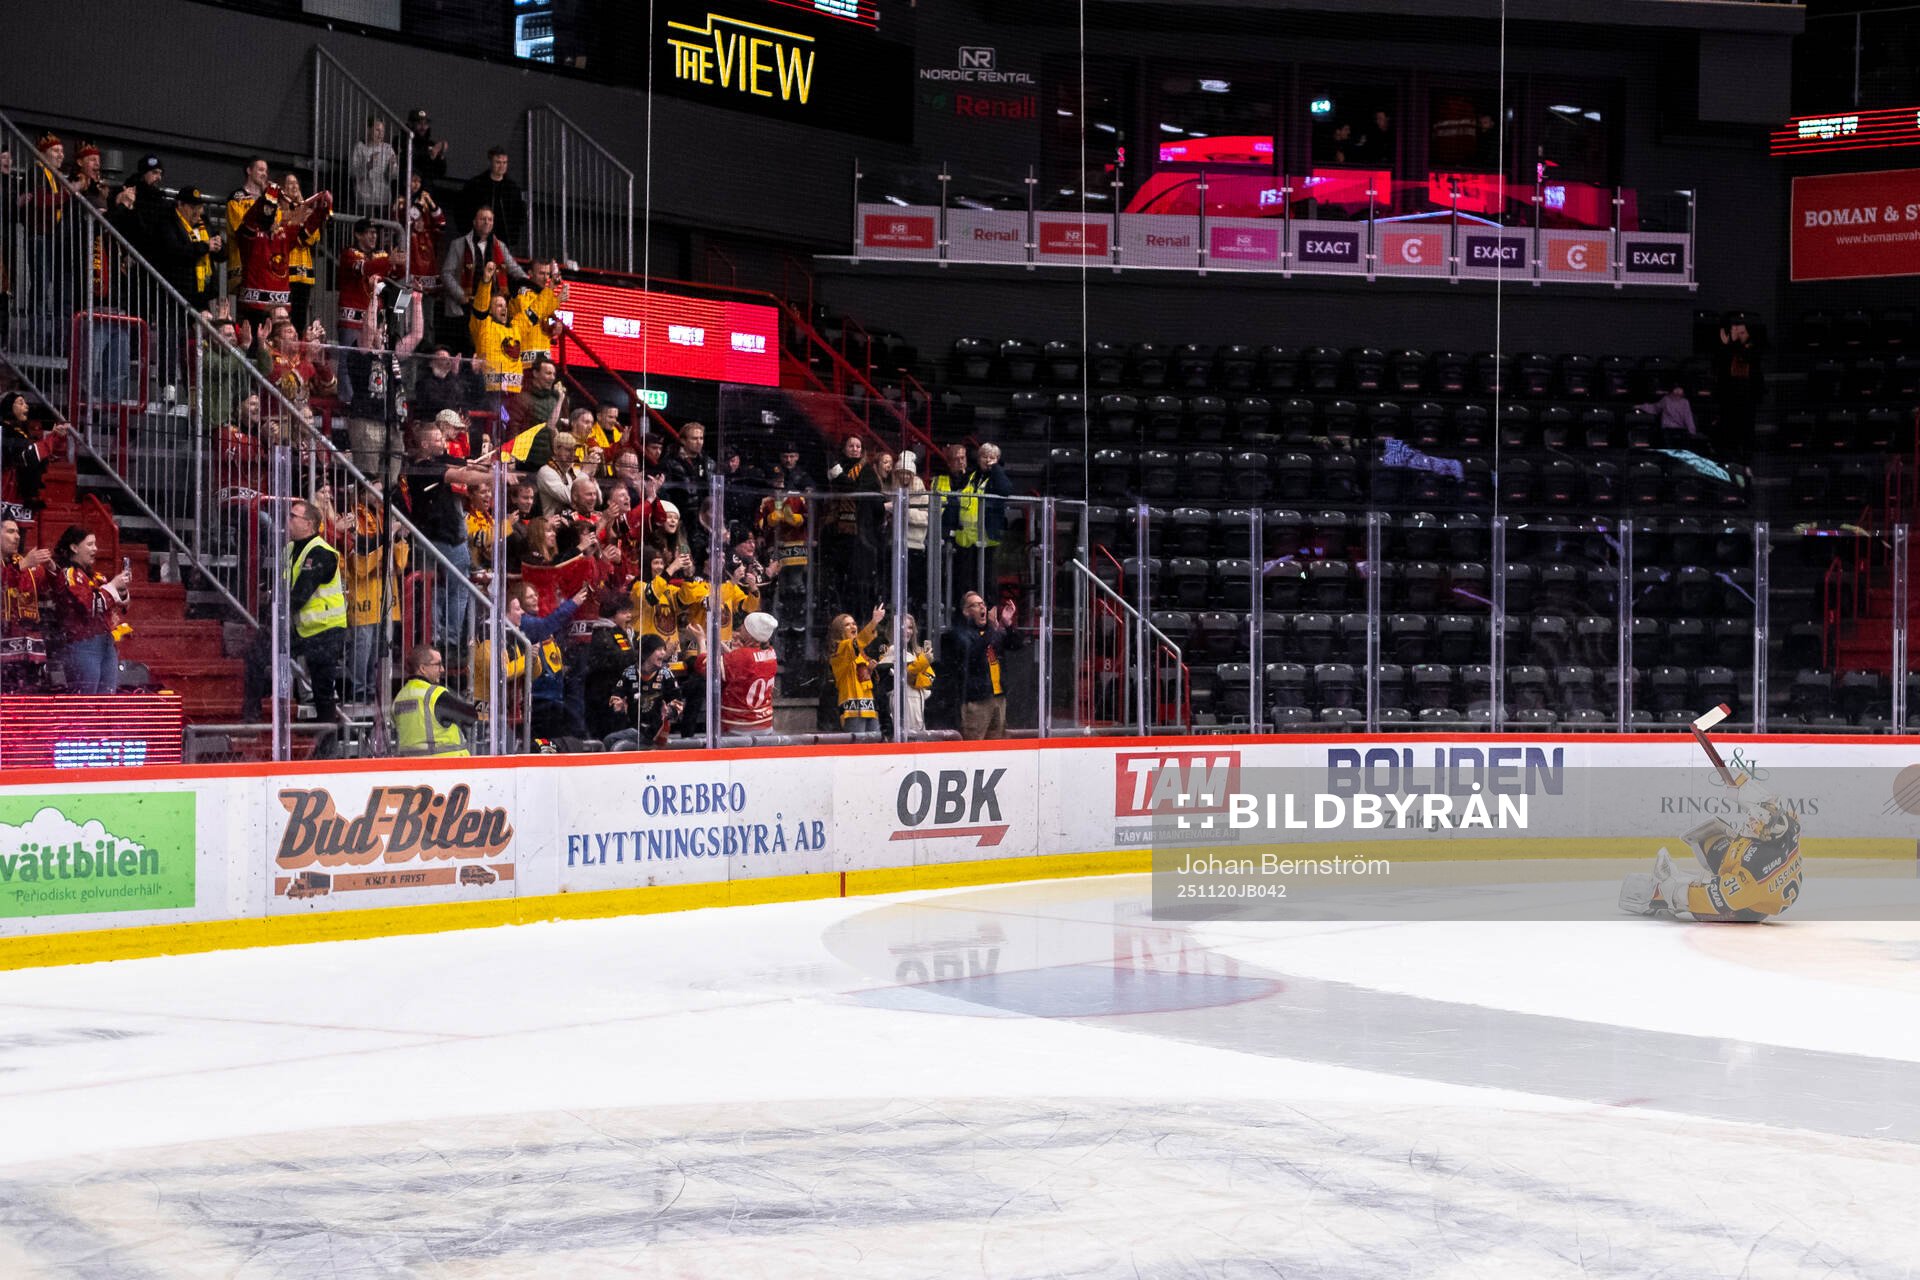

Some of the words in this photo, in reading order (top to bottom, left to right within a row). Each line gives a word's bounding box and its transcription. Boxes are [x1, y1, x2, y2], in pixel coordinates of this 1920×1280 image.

[667, 38, 714, 84] THE
[714, 29, 815, 104] VIEW
[920, 68, 974, 81] NORDIC
[978, 71, 1036, 84] RENTAL
[956, 95, 1037, 118] Renall
[1804, 207, 1879, 227] BOMAN
[1884, 206, 1900, 222] &
[974, 228, 1020, 241] Renall
[1145, 234, 1190, 247] Renall
[1305, 240, 1351, 254] EXACT
[1473, 245, 1518, 260] EXACT
[1633, 251, 1676, 266] EXACT
[1328, 747, 1564, 798] BOLIDEN
[1126, 757, 1231, 810] TAM
[642, 774, 746, 817] ÖREBRO
[896, 768, 1008, 827] OBK
[277, 784, 514, 866] Bud-Bilen
[567, 812, 787, 867] FLYTTNINGSBYRÅ
[795, 820, 826, 851] AB
[1143, 831, 1158, 842] AIR
[0, 840, 159, 882] vättbilen
[400, 873, 426, 883] FRYST
[16, 885, 77, 903] Periodiskt
